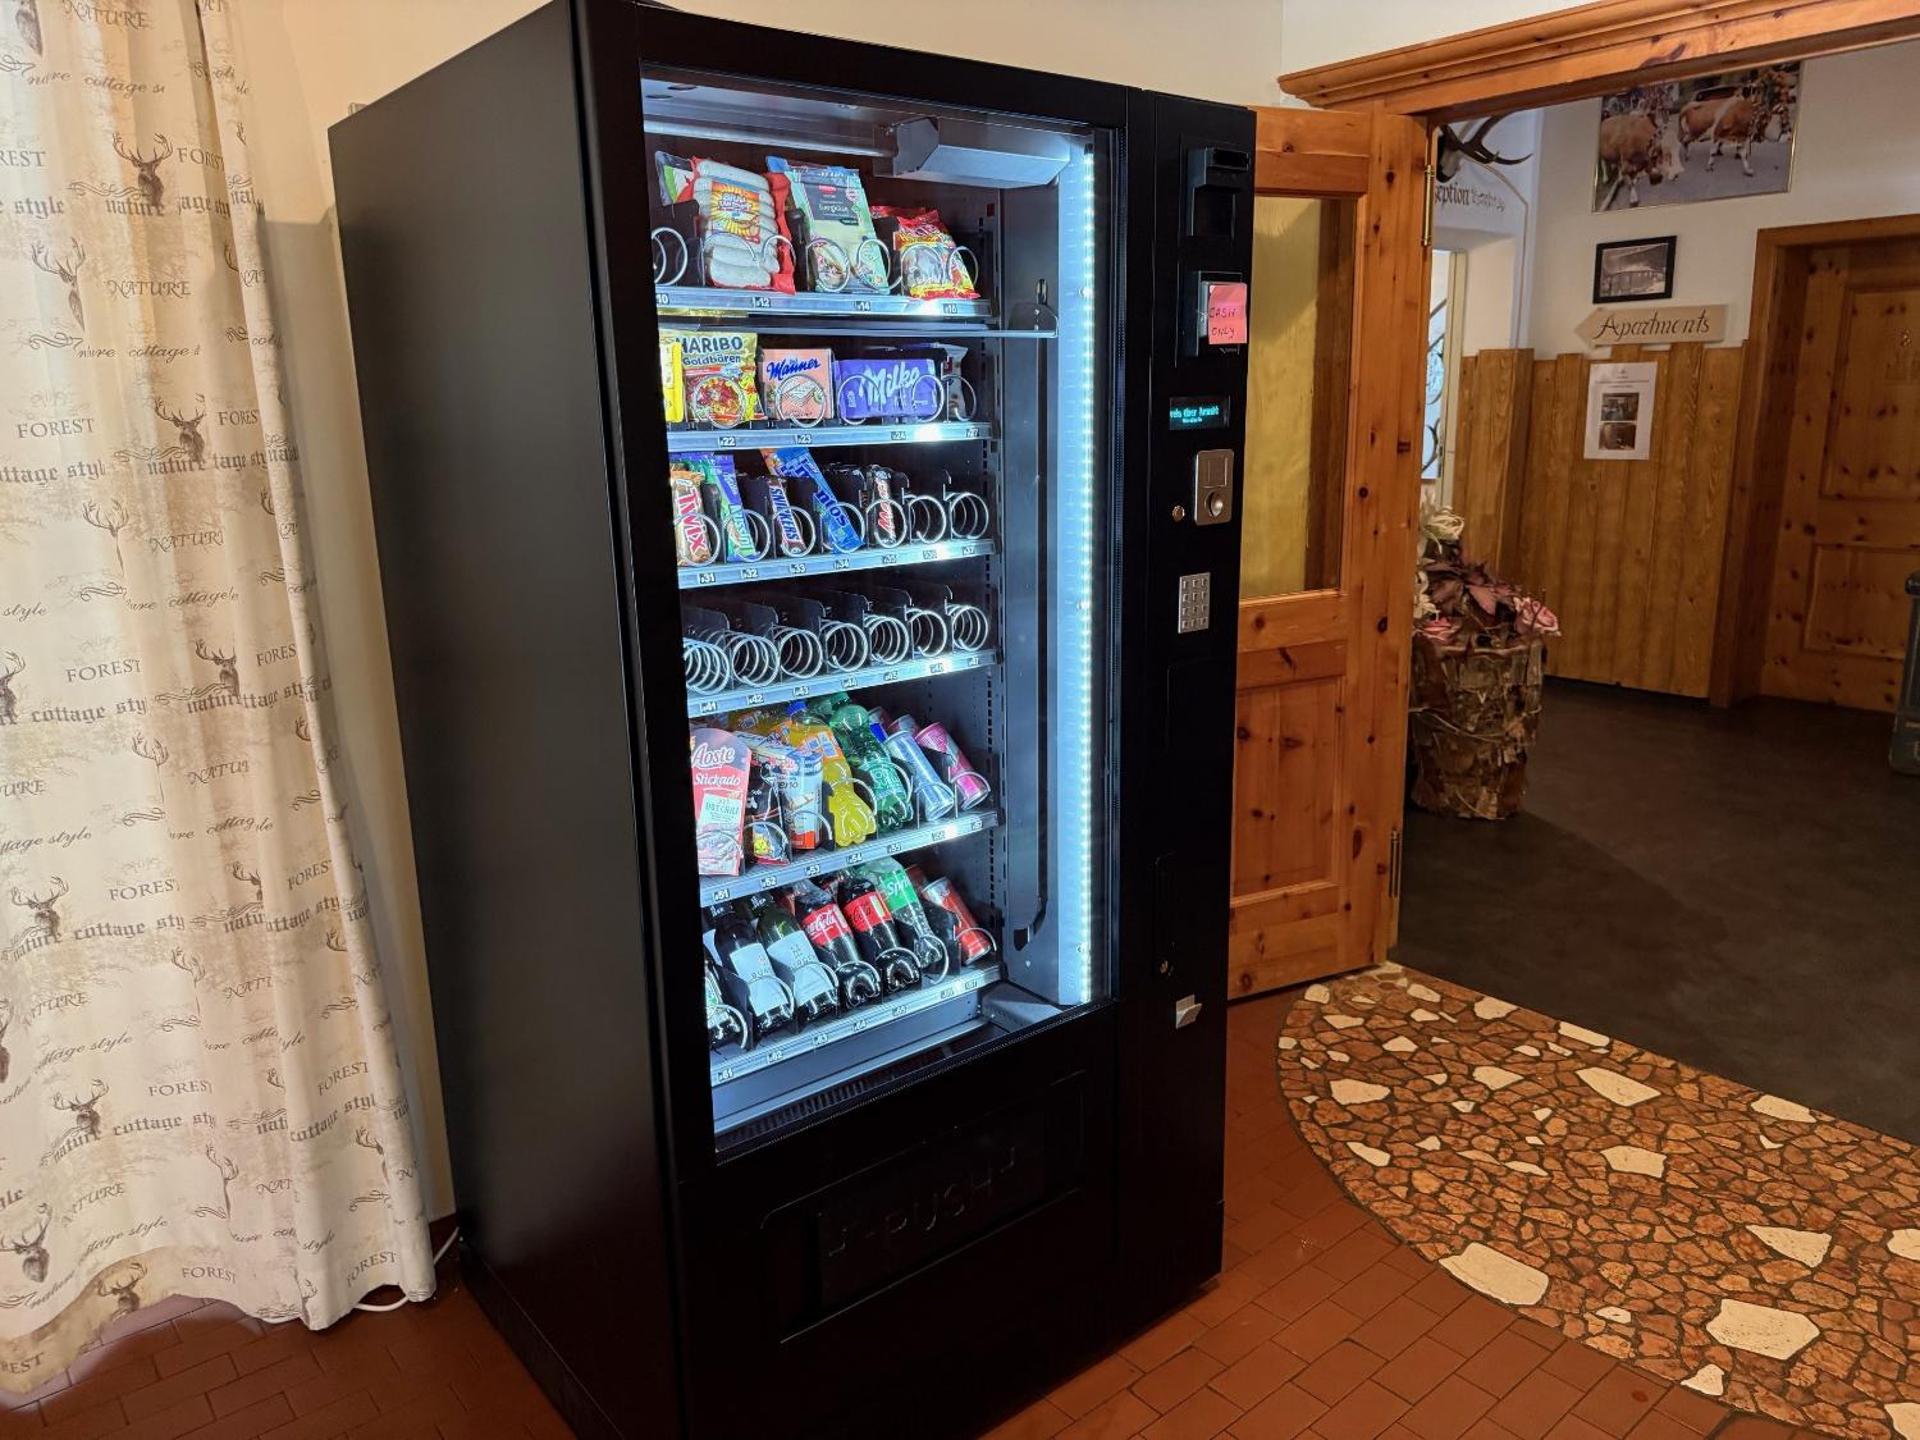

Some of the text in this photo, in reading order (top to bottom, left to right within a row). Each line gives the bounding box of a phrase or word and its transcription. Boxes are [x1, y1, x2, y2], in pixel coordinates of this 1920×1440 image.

[84, 76, 147, 98] cottage
[15, 197, 65, 219] style
[105, 280, 191, 298] NATURE
[1209, 306, 1236, 319] CASH
[1211, 327, 1235, 339] ONLY
[1593, 310, 1711, 339] Apartments
[128, 345, 194, 363] cottage
[676, 336, 743, 354] HARIBO
[767, 358, 821, 381] Manner
[857, 361, 920, 406] Milka
[17, 418, 95, 438] FOREST
[148, 456, 206, 475] nature
[678, 486, 708, 554] TWIX
[770, 486, 800, 543] SNICKERS
[3, 602, 47, 621] style
[66, 659, 141, 683] FOREST
[32, 705, 105, 724] cottage
[691, 742, 736, 769] Aoste
[50, 826, 92, 848] style
[73, 921, 146, 940] cottage
[90, 1031, 133, 1052] style
[318, 1062, 368, 1095] FOREST
[113, 1114, 182, 1136] cottage
[129, 1216, 168, 1237] style
[182, 1266, 237, 1285] FOREST
